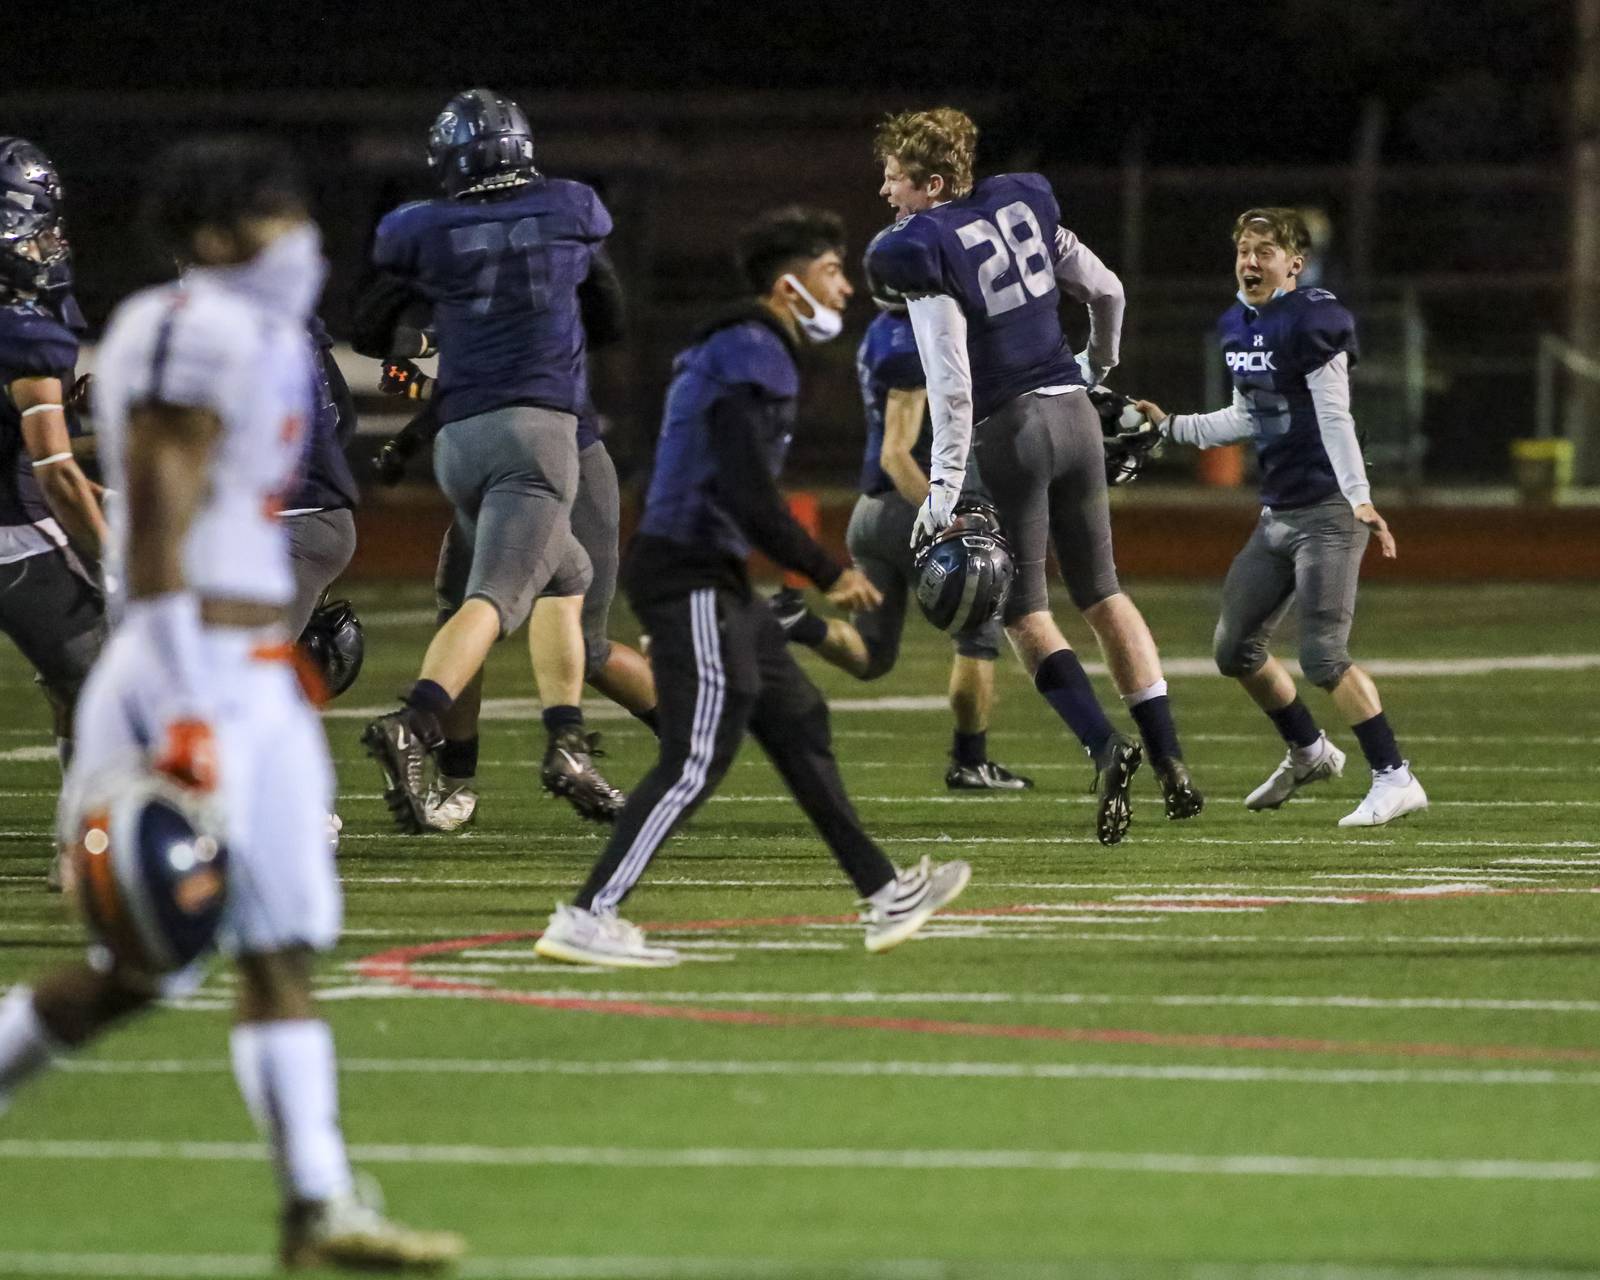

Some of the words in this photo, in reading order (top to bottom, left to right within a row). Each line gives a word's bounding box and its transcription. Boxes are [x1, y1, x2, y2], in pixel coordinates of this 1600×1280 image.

[449, 216, 553, 315] 71
[954, 200, 1057, 317] 28
[1225, 351, 1277, 371] PACK
